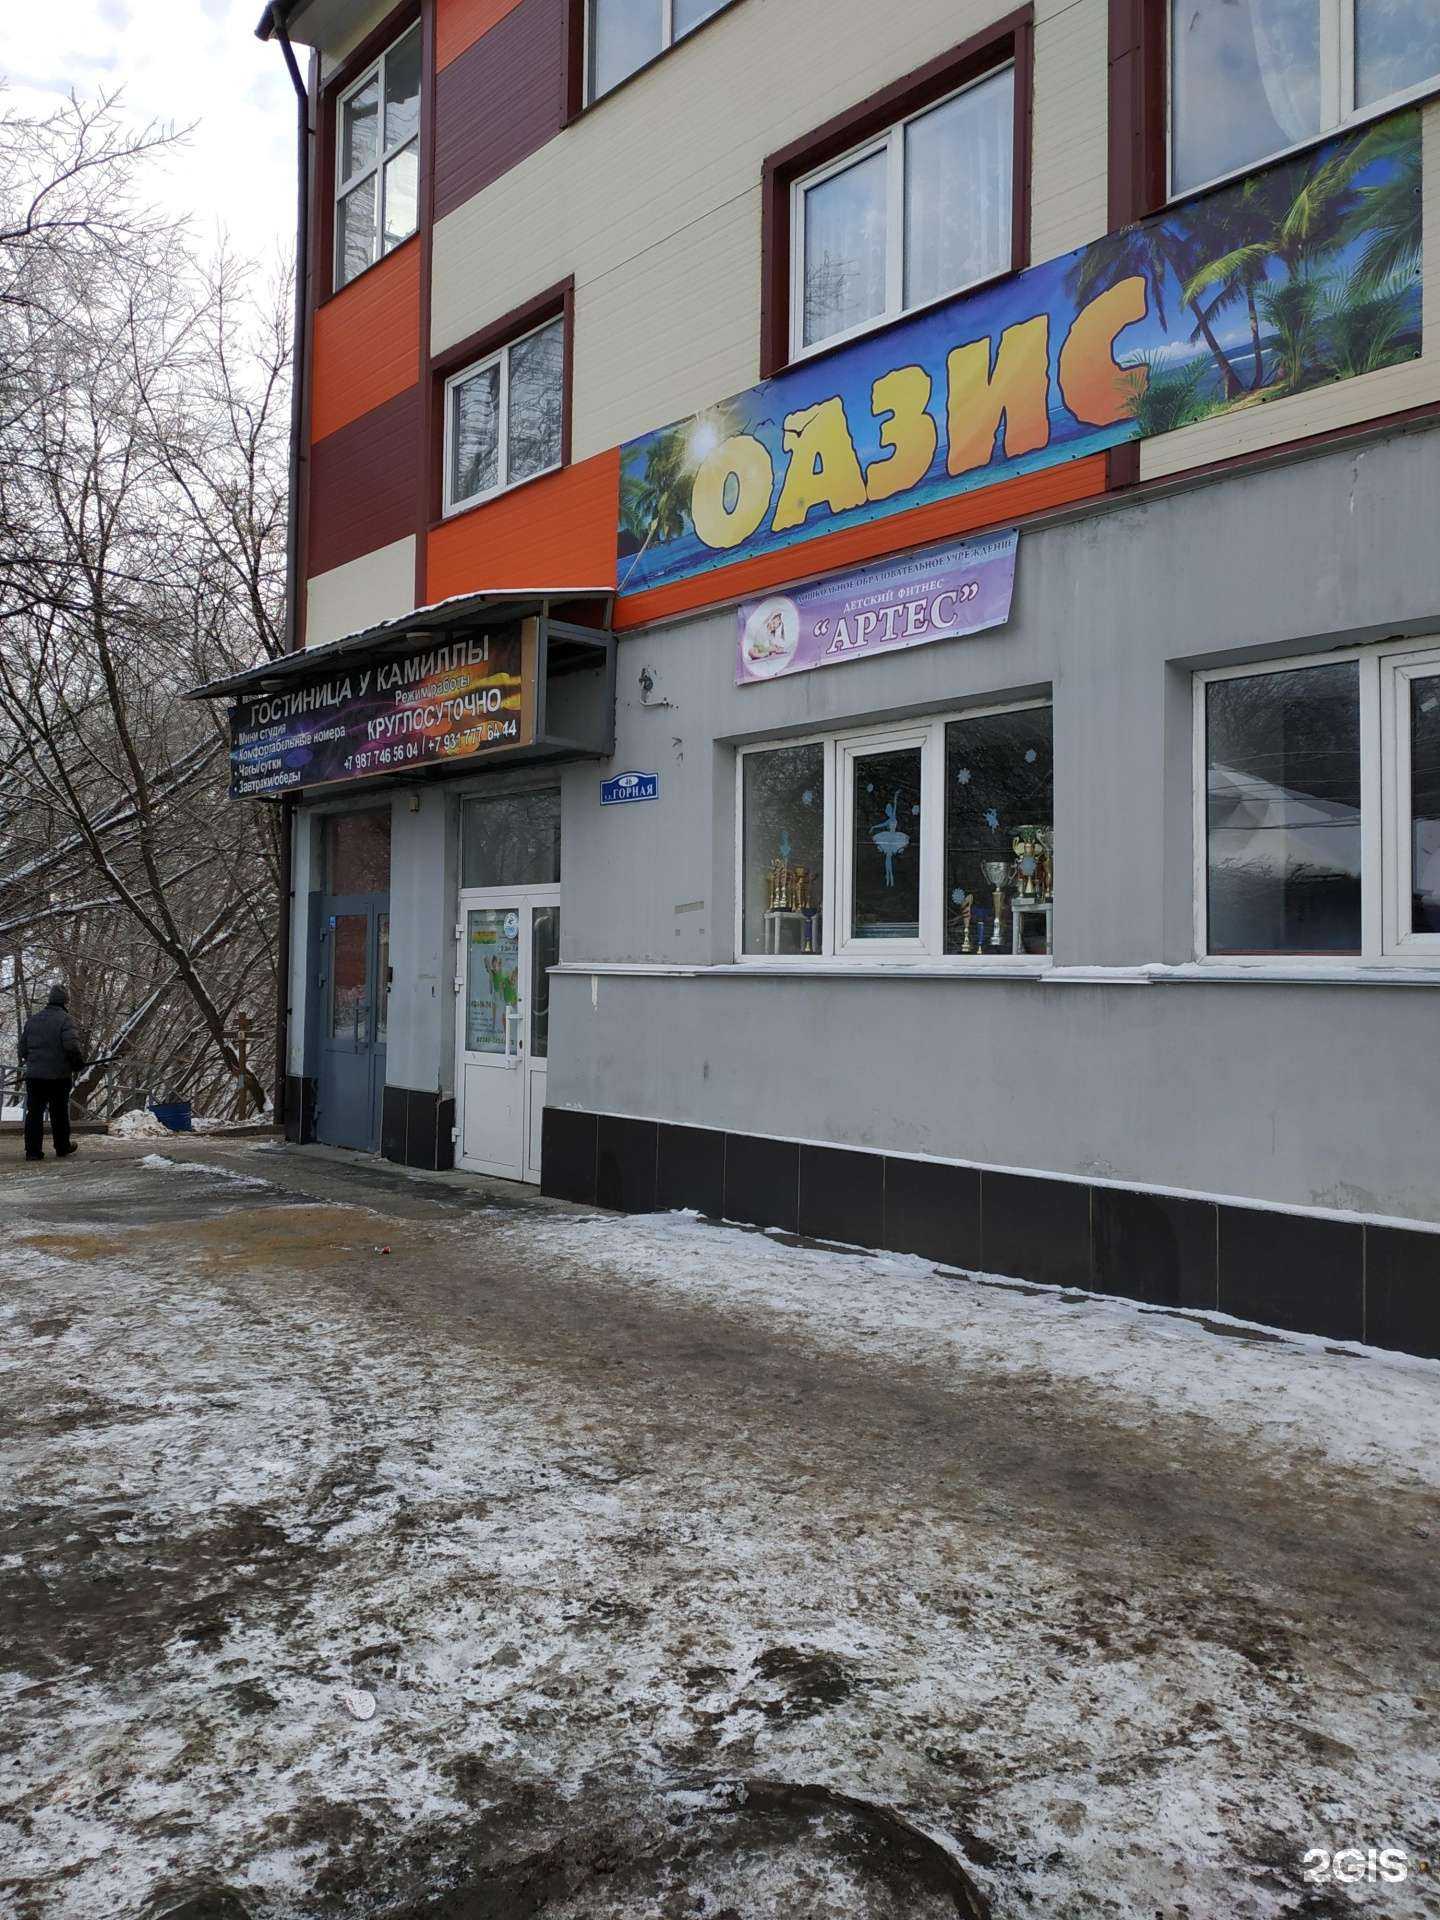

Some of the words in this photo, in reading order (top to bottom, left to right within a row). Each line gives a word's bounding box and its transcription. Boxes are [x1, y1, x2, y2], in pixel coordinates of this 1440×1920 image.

[690, 275, 1150, 550] ОАЗИС
[855, 557, 944, 588] ОБРАЗОВАТЕЛЬНОЕ
[946, 538, 1016, 562] УЧРЕЖДЕНИЕ
[843, 590, 893, 613] ДЕТСКИЙ
[897, 578, 944, 599] ФИТНЕС
[250, 677, 352, 727] ГОСТИНИЦА
[358, 671, 370, 697] У
[376, 634, 489, 692] КАМИЛЛЫ
[395, 686, 429, 706] Режим
[430, 675, 471, 699] работы
[238, 731, 259, 745] Мини
[259, 723, 287, 741] студия
[367, 688, 502, 741] КРУГЛОСУТОЧНО
[238, 734, 311, 760] Комфортабельные
[313, 725, 346, 743] номера
[344, 756, 353, 771] +7
[355, 752, 372, 769] 987
[374, 748, 390, 765] 746
[393, 745, 404, 760] 56
[406, 742, 418, 759] 04
[428, 737, 441, 752] +7
[487, 724, 500, 741] 64
[503, 719, 517, 737] 44
[613, 784, 653, 799] ГОРНАЯ
